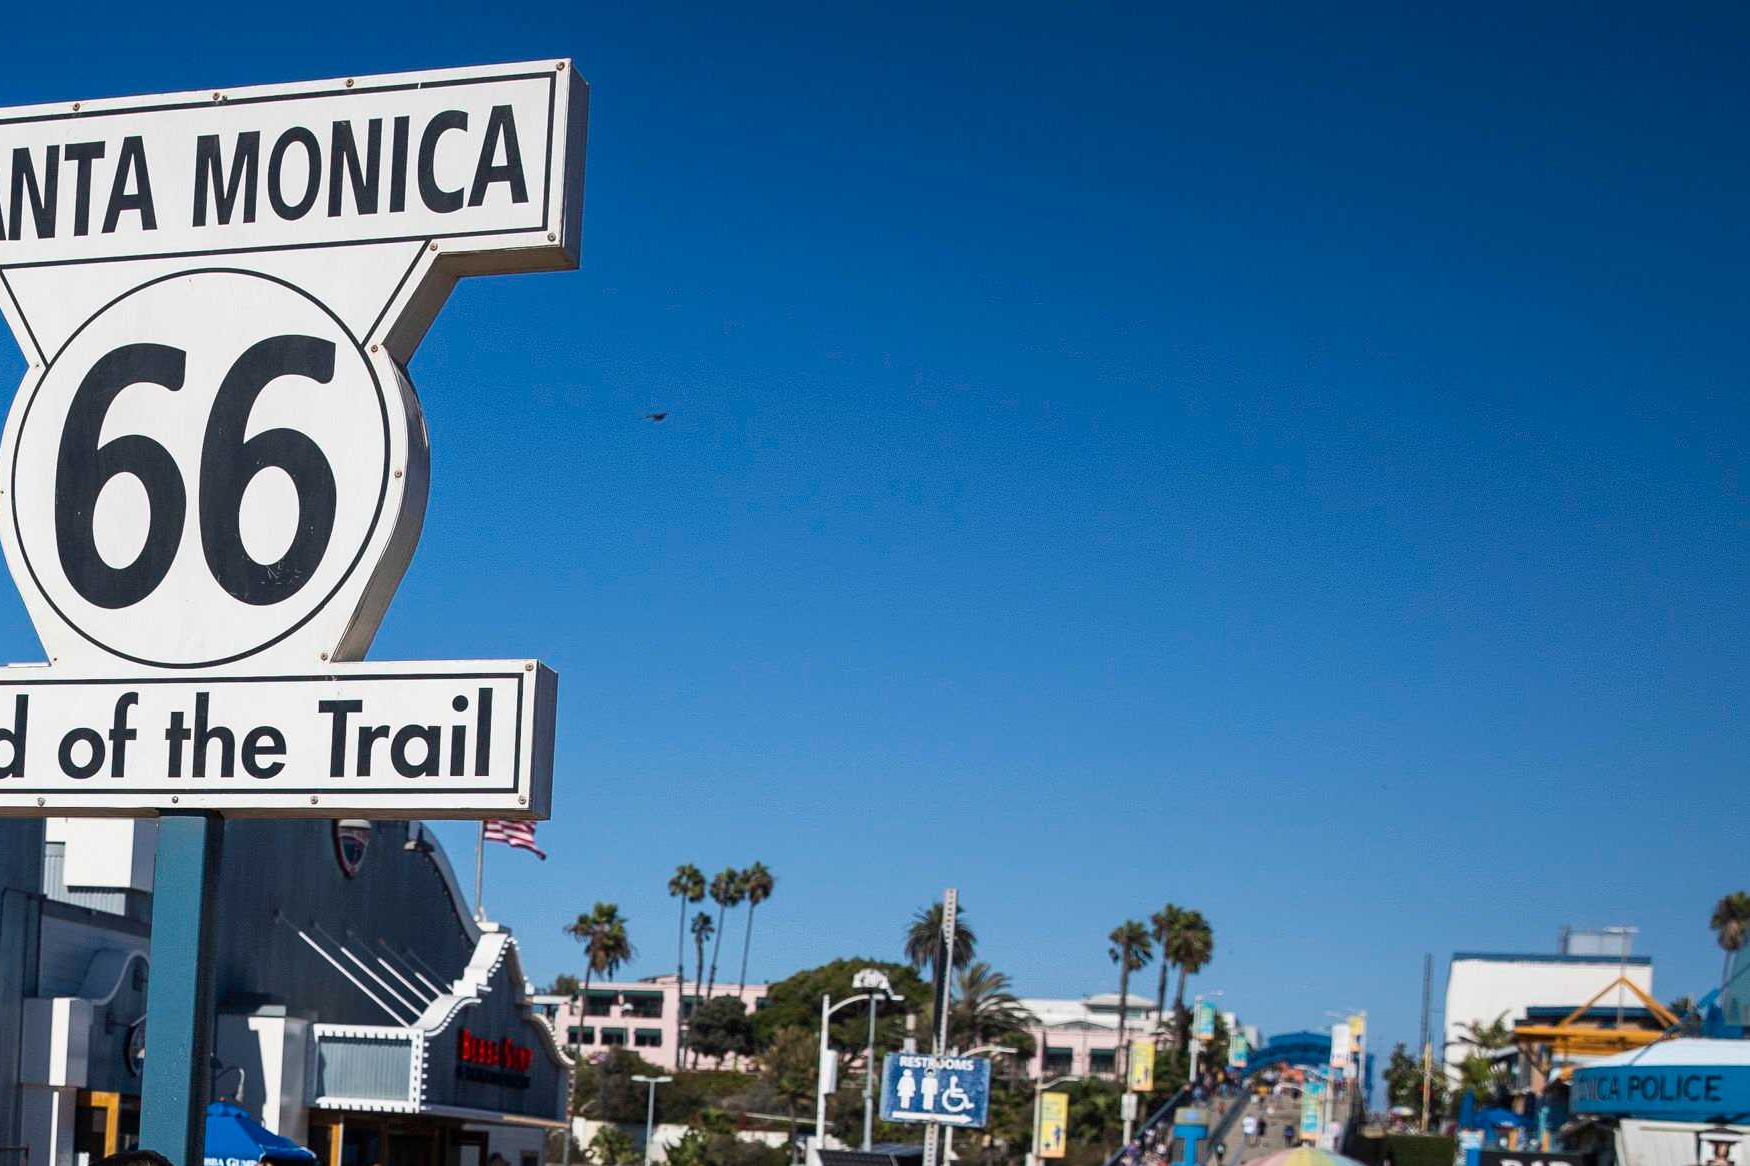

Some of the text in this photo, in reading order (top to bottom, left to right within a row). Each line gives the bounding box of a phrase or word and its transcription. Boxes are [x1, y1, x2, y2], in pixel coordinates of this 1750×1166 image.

[191, 103, 529, 228] MONICA
[54, 333, 337, 609] 66
[57, 691, 139, 780] of
[165, 691, 287, 780] the
[318, 687, 493, 778] Trail
[899, 1056, 974, 1071] RESTROOMS
[1626, 1074, 1723, 1102] POLICE
